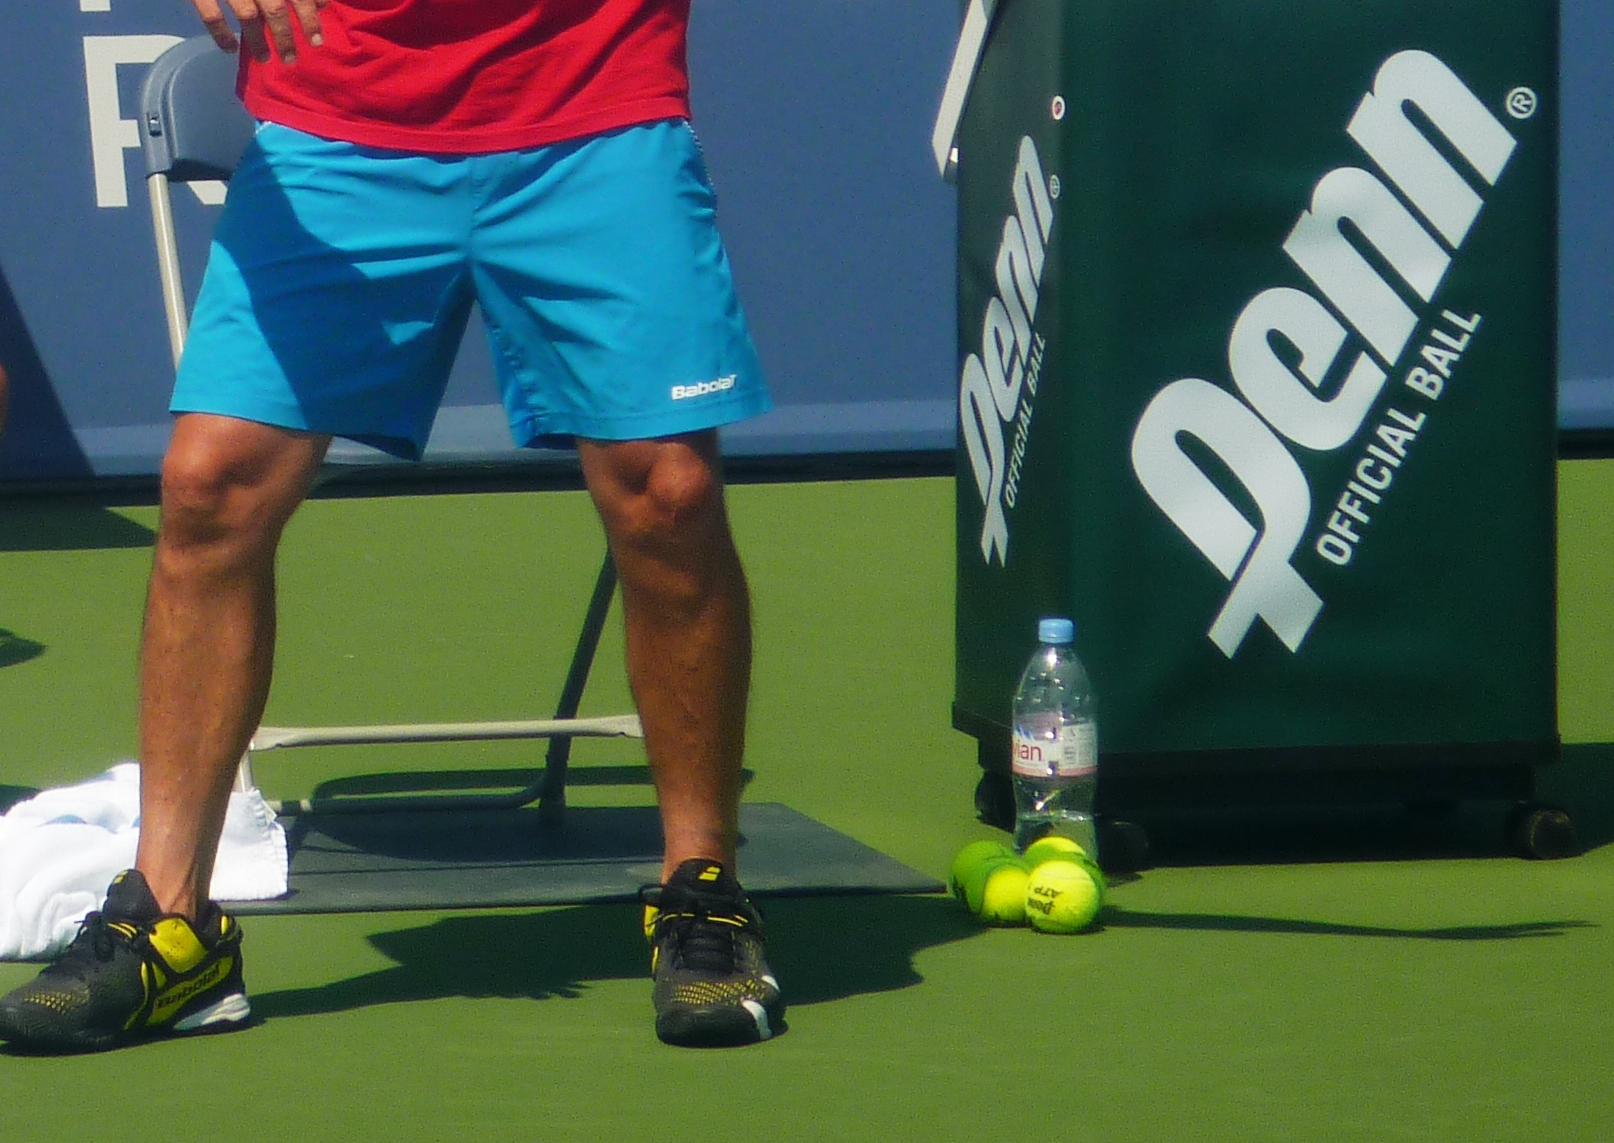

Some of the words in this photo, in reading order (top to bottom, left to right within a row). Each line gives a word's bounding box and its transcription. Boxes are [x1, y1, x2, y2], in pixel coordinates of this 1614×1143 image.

[1005, 403, 1034, 509] OFFICIAL
[1026, 331, 1048, 399] BALL
[1316, 406, 1427, 566] OFFICIAL
[1405, 310, 1482, 402] BALL
